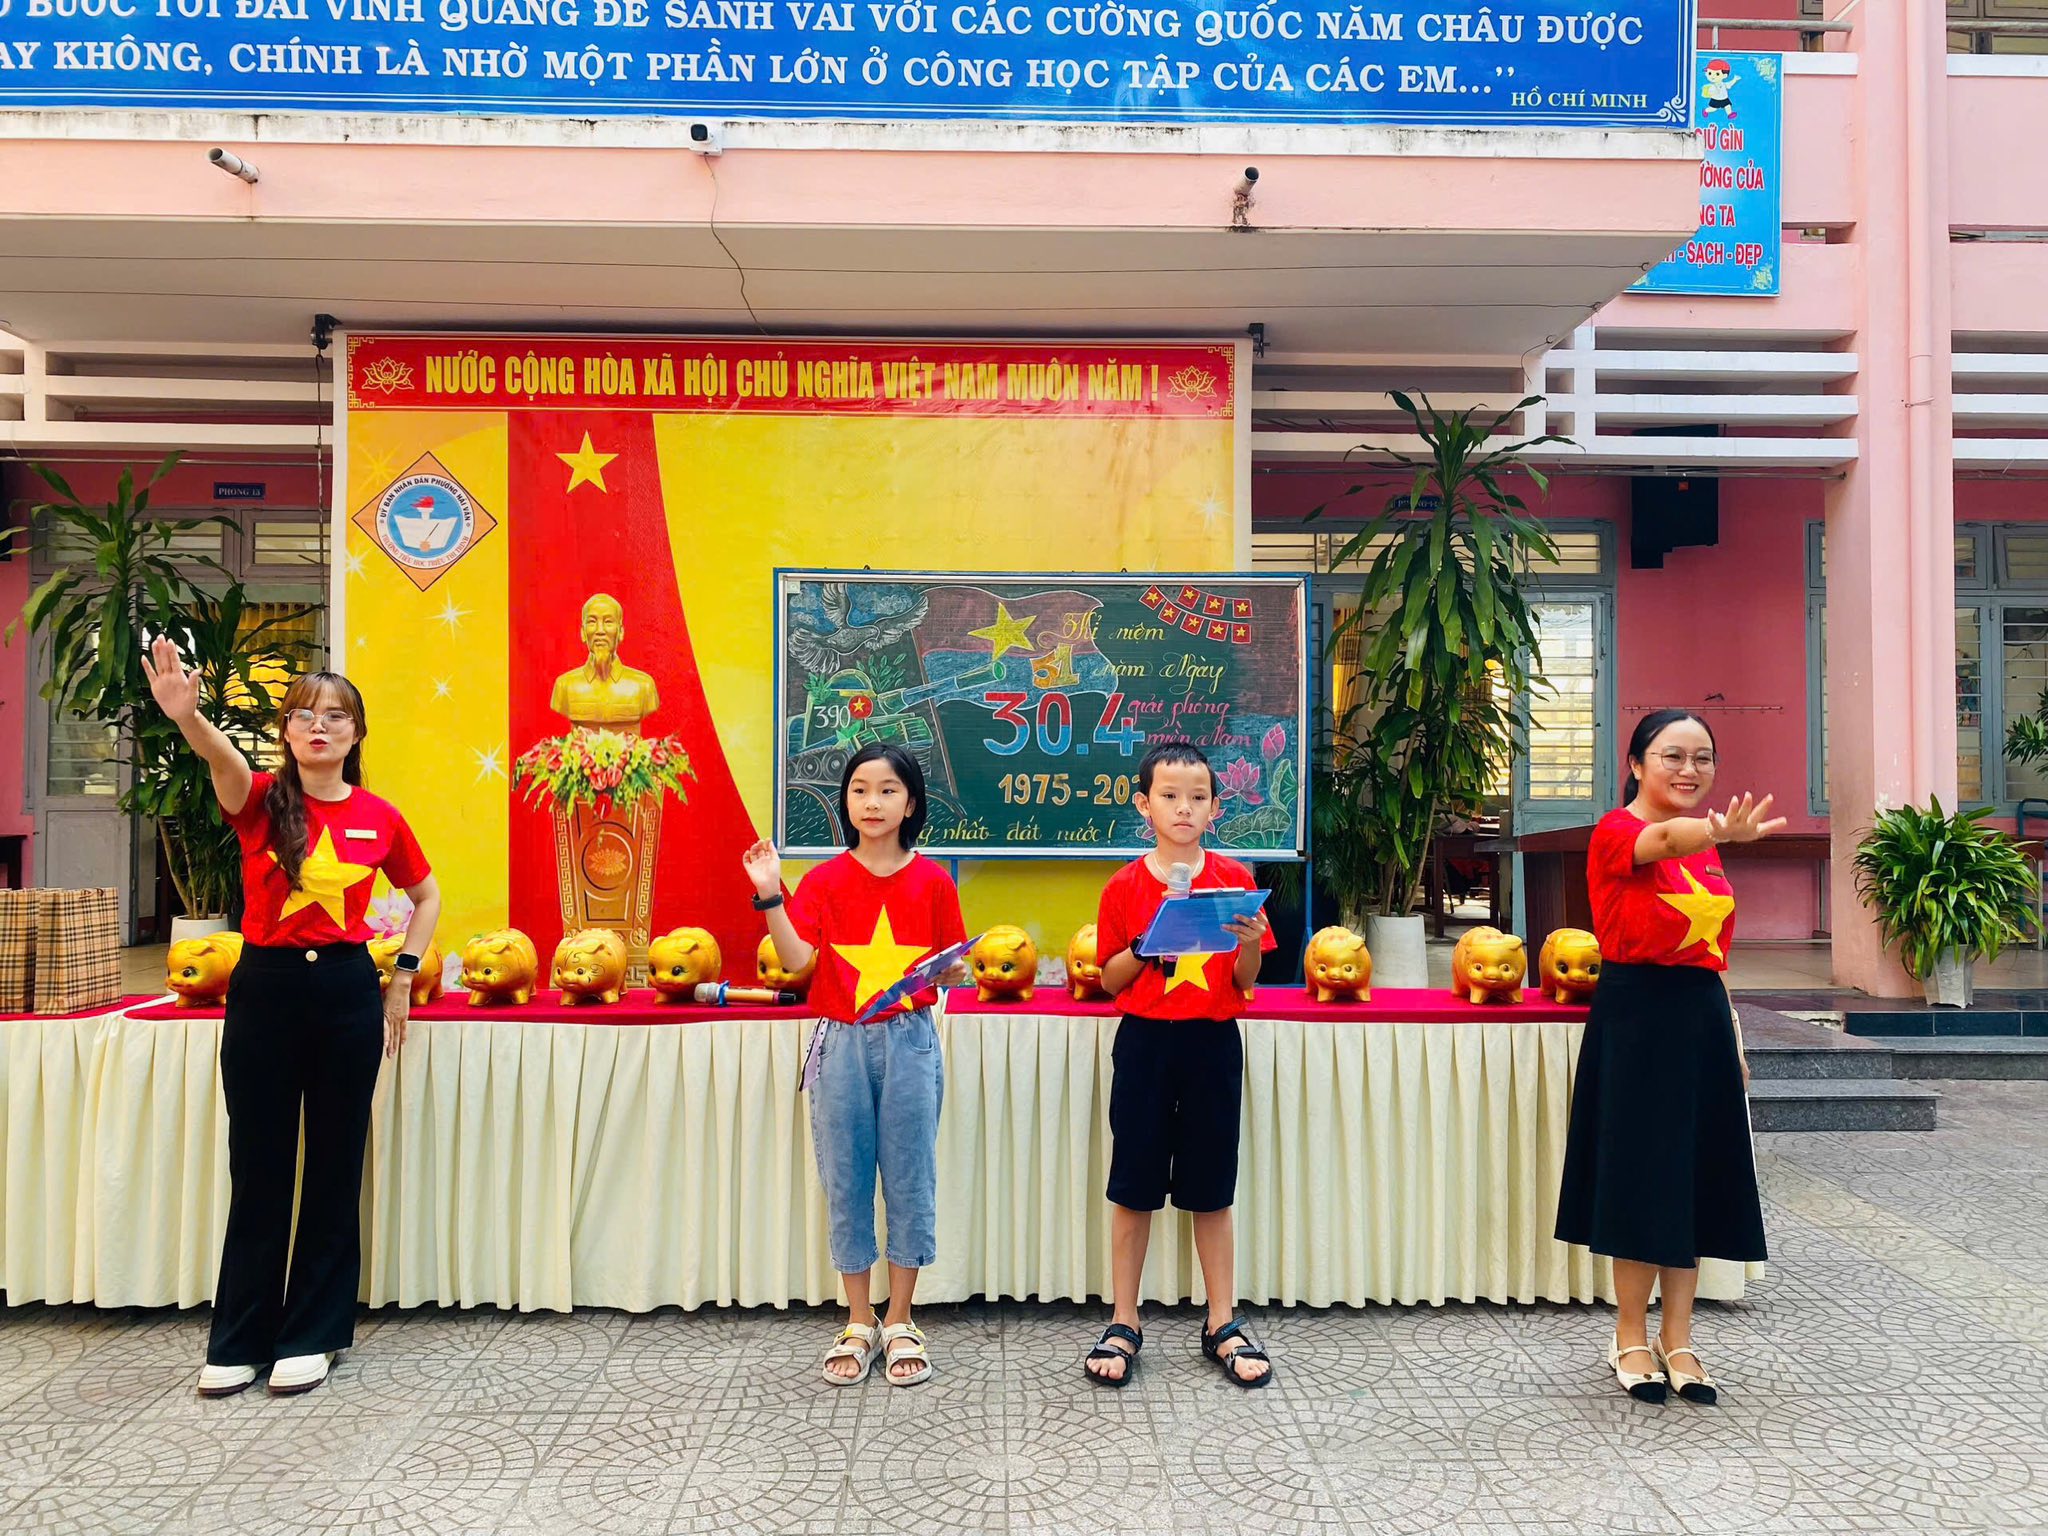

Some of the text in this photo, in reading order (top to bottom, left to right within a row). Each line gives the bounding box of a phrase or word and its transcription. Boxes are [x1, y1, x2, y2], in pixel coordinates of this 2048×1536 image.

[327, 0, 424, 21] VINH
[440, 0, 579, 31] QUANG
[787, 3, 854, 30] VAI
[868, 0, 937, 32] VỚI
[952, 0, 1031, 34] CÁC
[1047, 1, 1181, 37] CƯỜNG
[1196, 0, 1302, 46] QUỐC
[1317, 5, 1402, 40] NĂM
[1418, 7, 1524, 42] CHÂU
[1538, 12, 1642, 50] ĐƯỢC
[0, 42, 40, 69] AY
[54, 34, 212, 75] KHÔNG,
[230, 37, 362, 73] CHÍNH
[376, 39, 429, 75] LÀ
[443, 42, 528, 77] NHỜ
[544, 44, 632, 86] MỘT
[647, 38, 755, 81] PHẦN
[770, 48, 848, 83] LỚN
[863, 46, 888, 84] Ở
[904, 51, 1012, 86] CÔNG
[1027, 60, 1109, 94] HỌC
[1123, 54, 1199, 95] TẬP
[1214, 53, 1294, 91] CỦA
[1306, 57, 1384, 92] CÁC
[1511, 86, 1648, 108] HỒ CHÍ MINH
[1720, 123, 1743, 150] GÌN
[1736, 159, 1764, 189] CỦA
[1719, 205, 1735, 226] TA
[1687, 241, 1723, 268] SẠCH
[1735, 243, 1762, 269] ĐẸP
[427, 350, 495, 393] NƯỚC
[506, 351, 574, 400] CỘNG
[585, 353, 634, 395] HÒA
[644, 354, 675, 395] XÃ
[685, 353, 727, 403] HỘI
[737, 352, 788, 397] CHỦ
[798, 356, 874, 399] NGHĨA
[883, 357, 936, 406] VIỆT
[945, 364, 998, 401] NAM
[1007, 358, 1078, 401] MUÔN
[1088, 358, 1142, 401] NĂM
[383, 492, 396, 507] BAN
[1109, 621, 1166, 644] niệm
[1030, 643, 1226, 694] 51 năm Ngày
[813, 704, 850, 728] 390
[983, 691, 1145, 756] 30.4
[1170, 691, 1231, 728] phóng
[942, 816, 995, 841] nhất
[1006, 816, 1042, 841] đất
